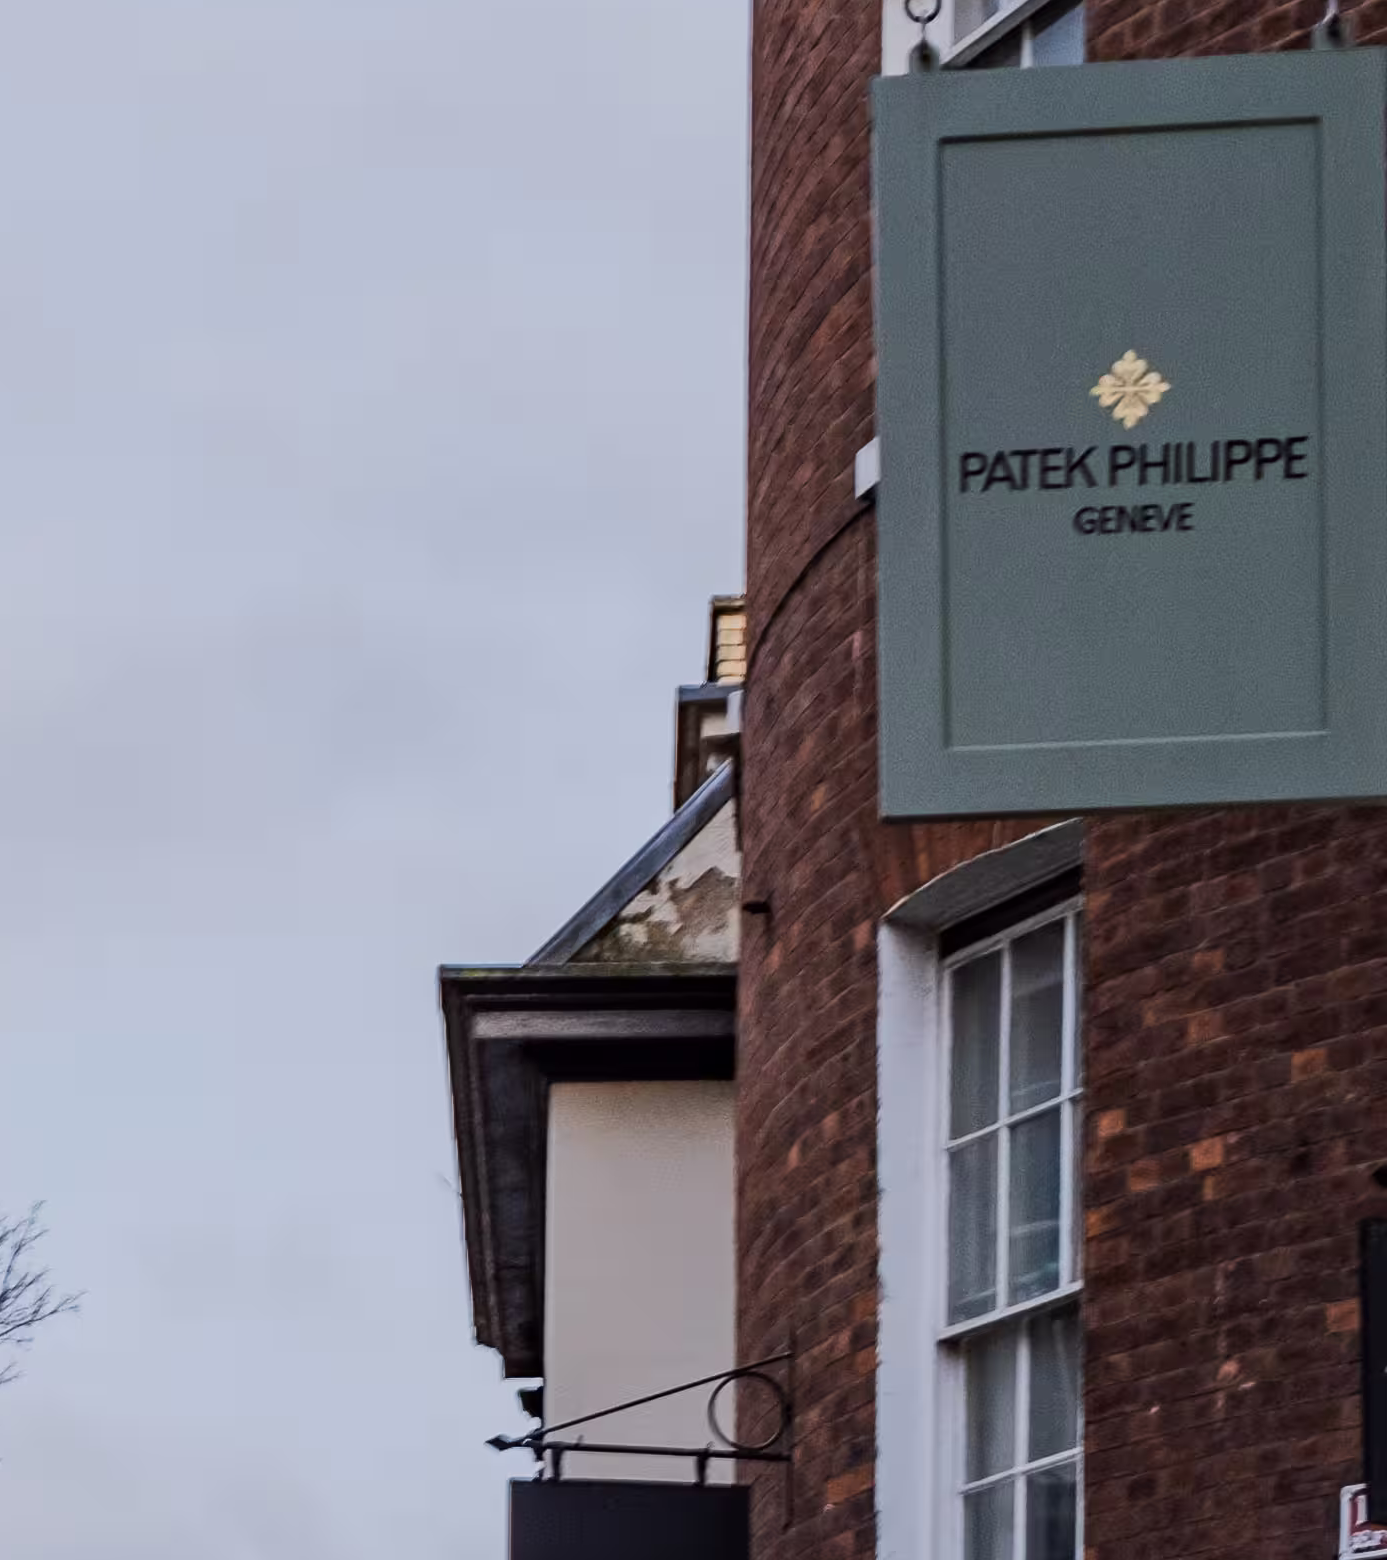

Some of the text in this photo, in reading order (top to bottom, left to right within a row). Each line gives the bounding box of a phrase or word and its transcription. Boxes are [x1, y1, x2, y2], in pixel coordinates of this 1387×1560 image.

[959, 435, 1309, 493] PATEK PHILIPPE
[1073, 501, 1195, 536] GENEVE
